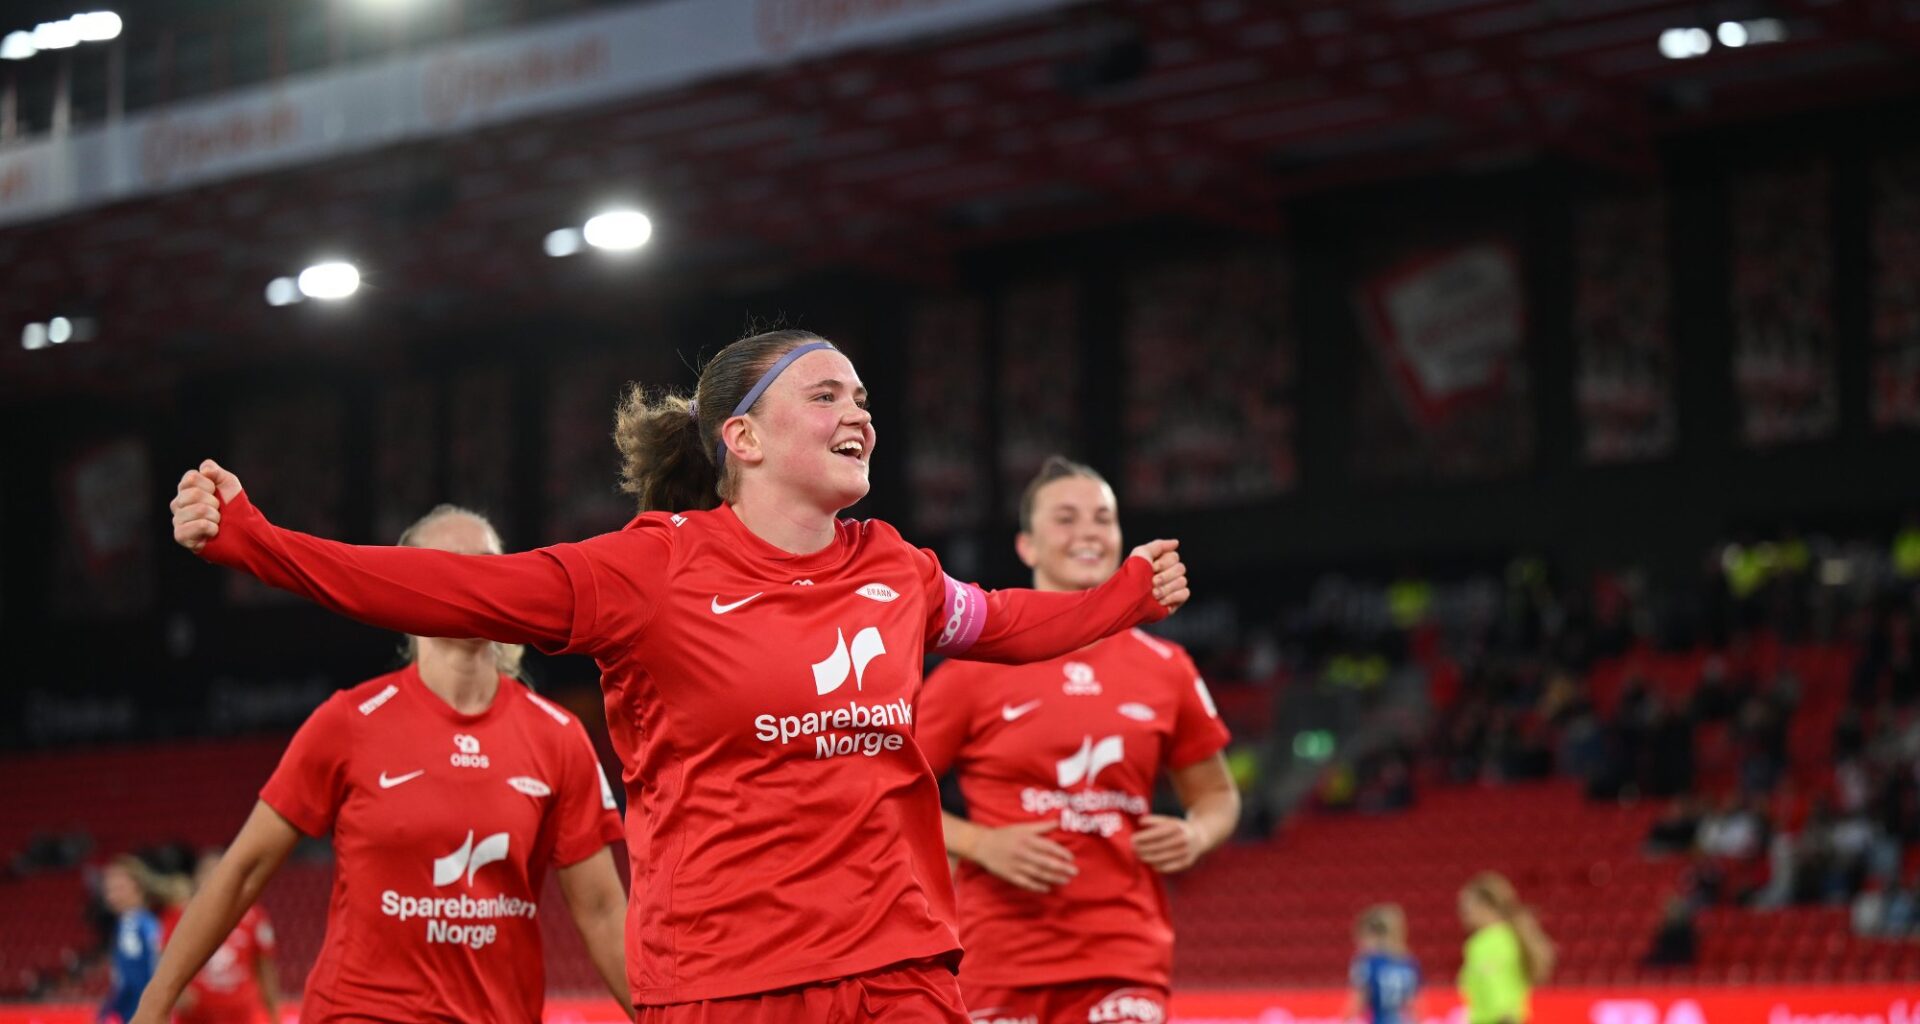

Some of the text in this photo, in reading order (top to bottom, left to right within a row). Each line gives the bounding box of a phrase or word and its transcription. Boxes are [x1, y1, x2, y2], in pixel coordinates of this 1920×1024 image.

[816, 732, 904, 759] Norge
[450, 753, 490, 769] OBOS
[381, 890, 537, 921] Sparebanken
[427, 919, 497, 950] Norge
